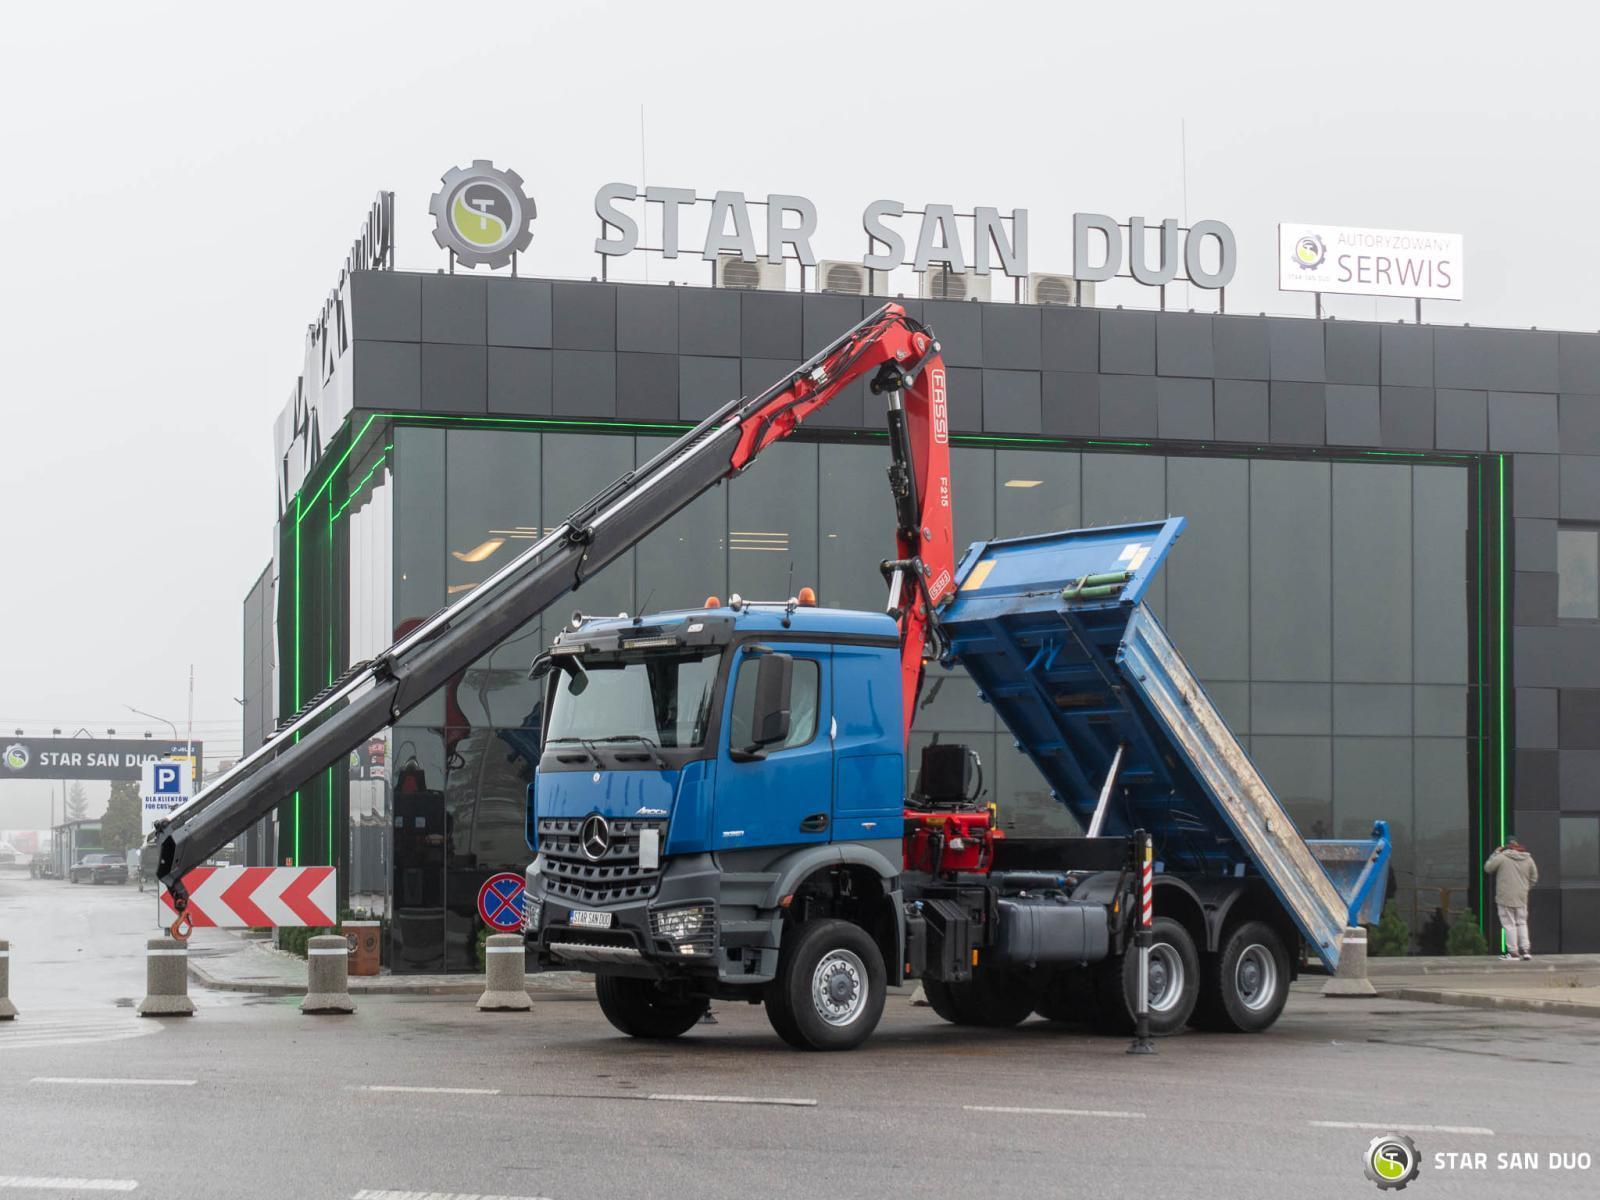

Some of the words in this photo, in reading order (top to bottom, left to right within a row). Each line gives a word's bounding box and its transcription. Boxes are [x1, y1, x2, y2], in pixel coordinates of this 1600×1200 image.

[595, 182, 817, 265] STAR
[863, 199, 1028, 277] SAN
[1073, 212, 1237, 289] DUO
[1337, 232, 1452, 251] AUTORYZOWANY
[1337, 254, 1452, 288] SERWIS
[933, 372, 947, 439] FASSI
[930, 571, 949, 599] FASSI
[40, 752, 82, 766] STAR
[87, 753, 119, 767] SAN
[574, 911, 588, 923] STAR
[588, 912, 599, 924] SAN
